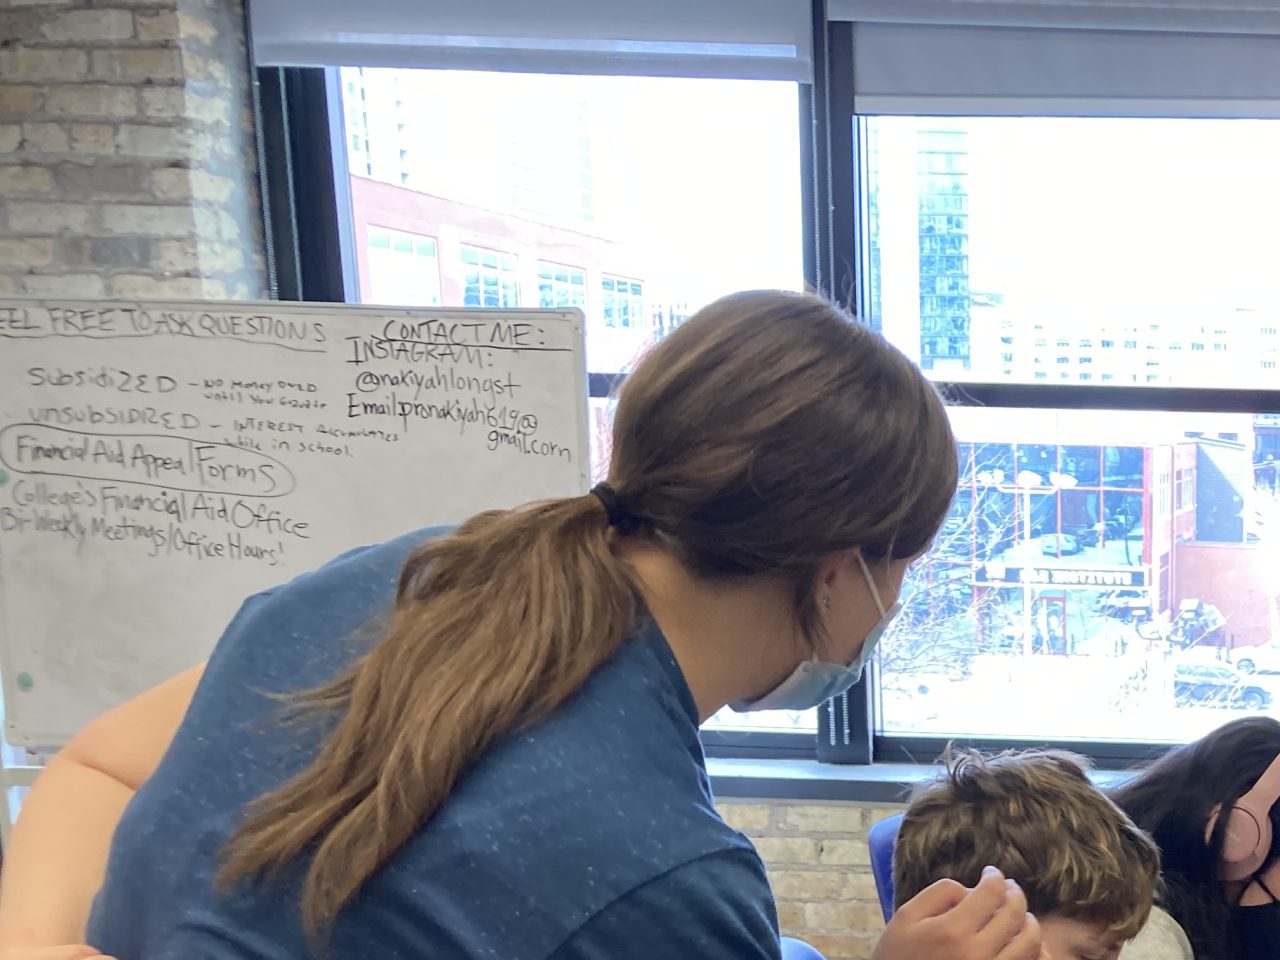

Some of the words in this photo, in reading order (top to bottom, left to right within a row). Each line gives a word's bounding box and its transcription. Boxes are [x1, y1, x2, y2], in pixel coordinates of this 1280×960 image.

[47, 307, 116, 332] FREE
[120, 307, 152, 331] TO
[154, 312, 197, 338] ASK
[199, 313, 327, 343] QUESTIONS
[383, 319, 486, 347] CONTACT
[489, 322, 546, 346] ME:
[345, 336, 494, 370] INSTAGRAM:
[233, 418, 304, 433] INTEREST
[15, 434, 89, 464] Financial
[92, 437, 127, 468] Aid
[130, 440, 193, 478] Appeal
[194, 445, 276, 494] Forms
[101, 486, 188, 523] Financial
[191, 493, 228, 522] Aid
[231, 500, 312, 539] Office
